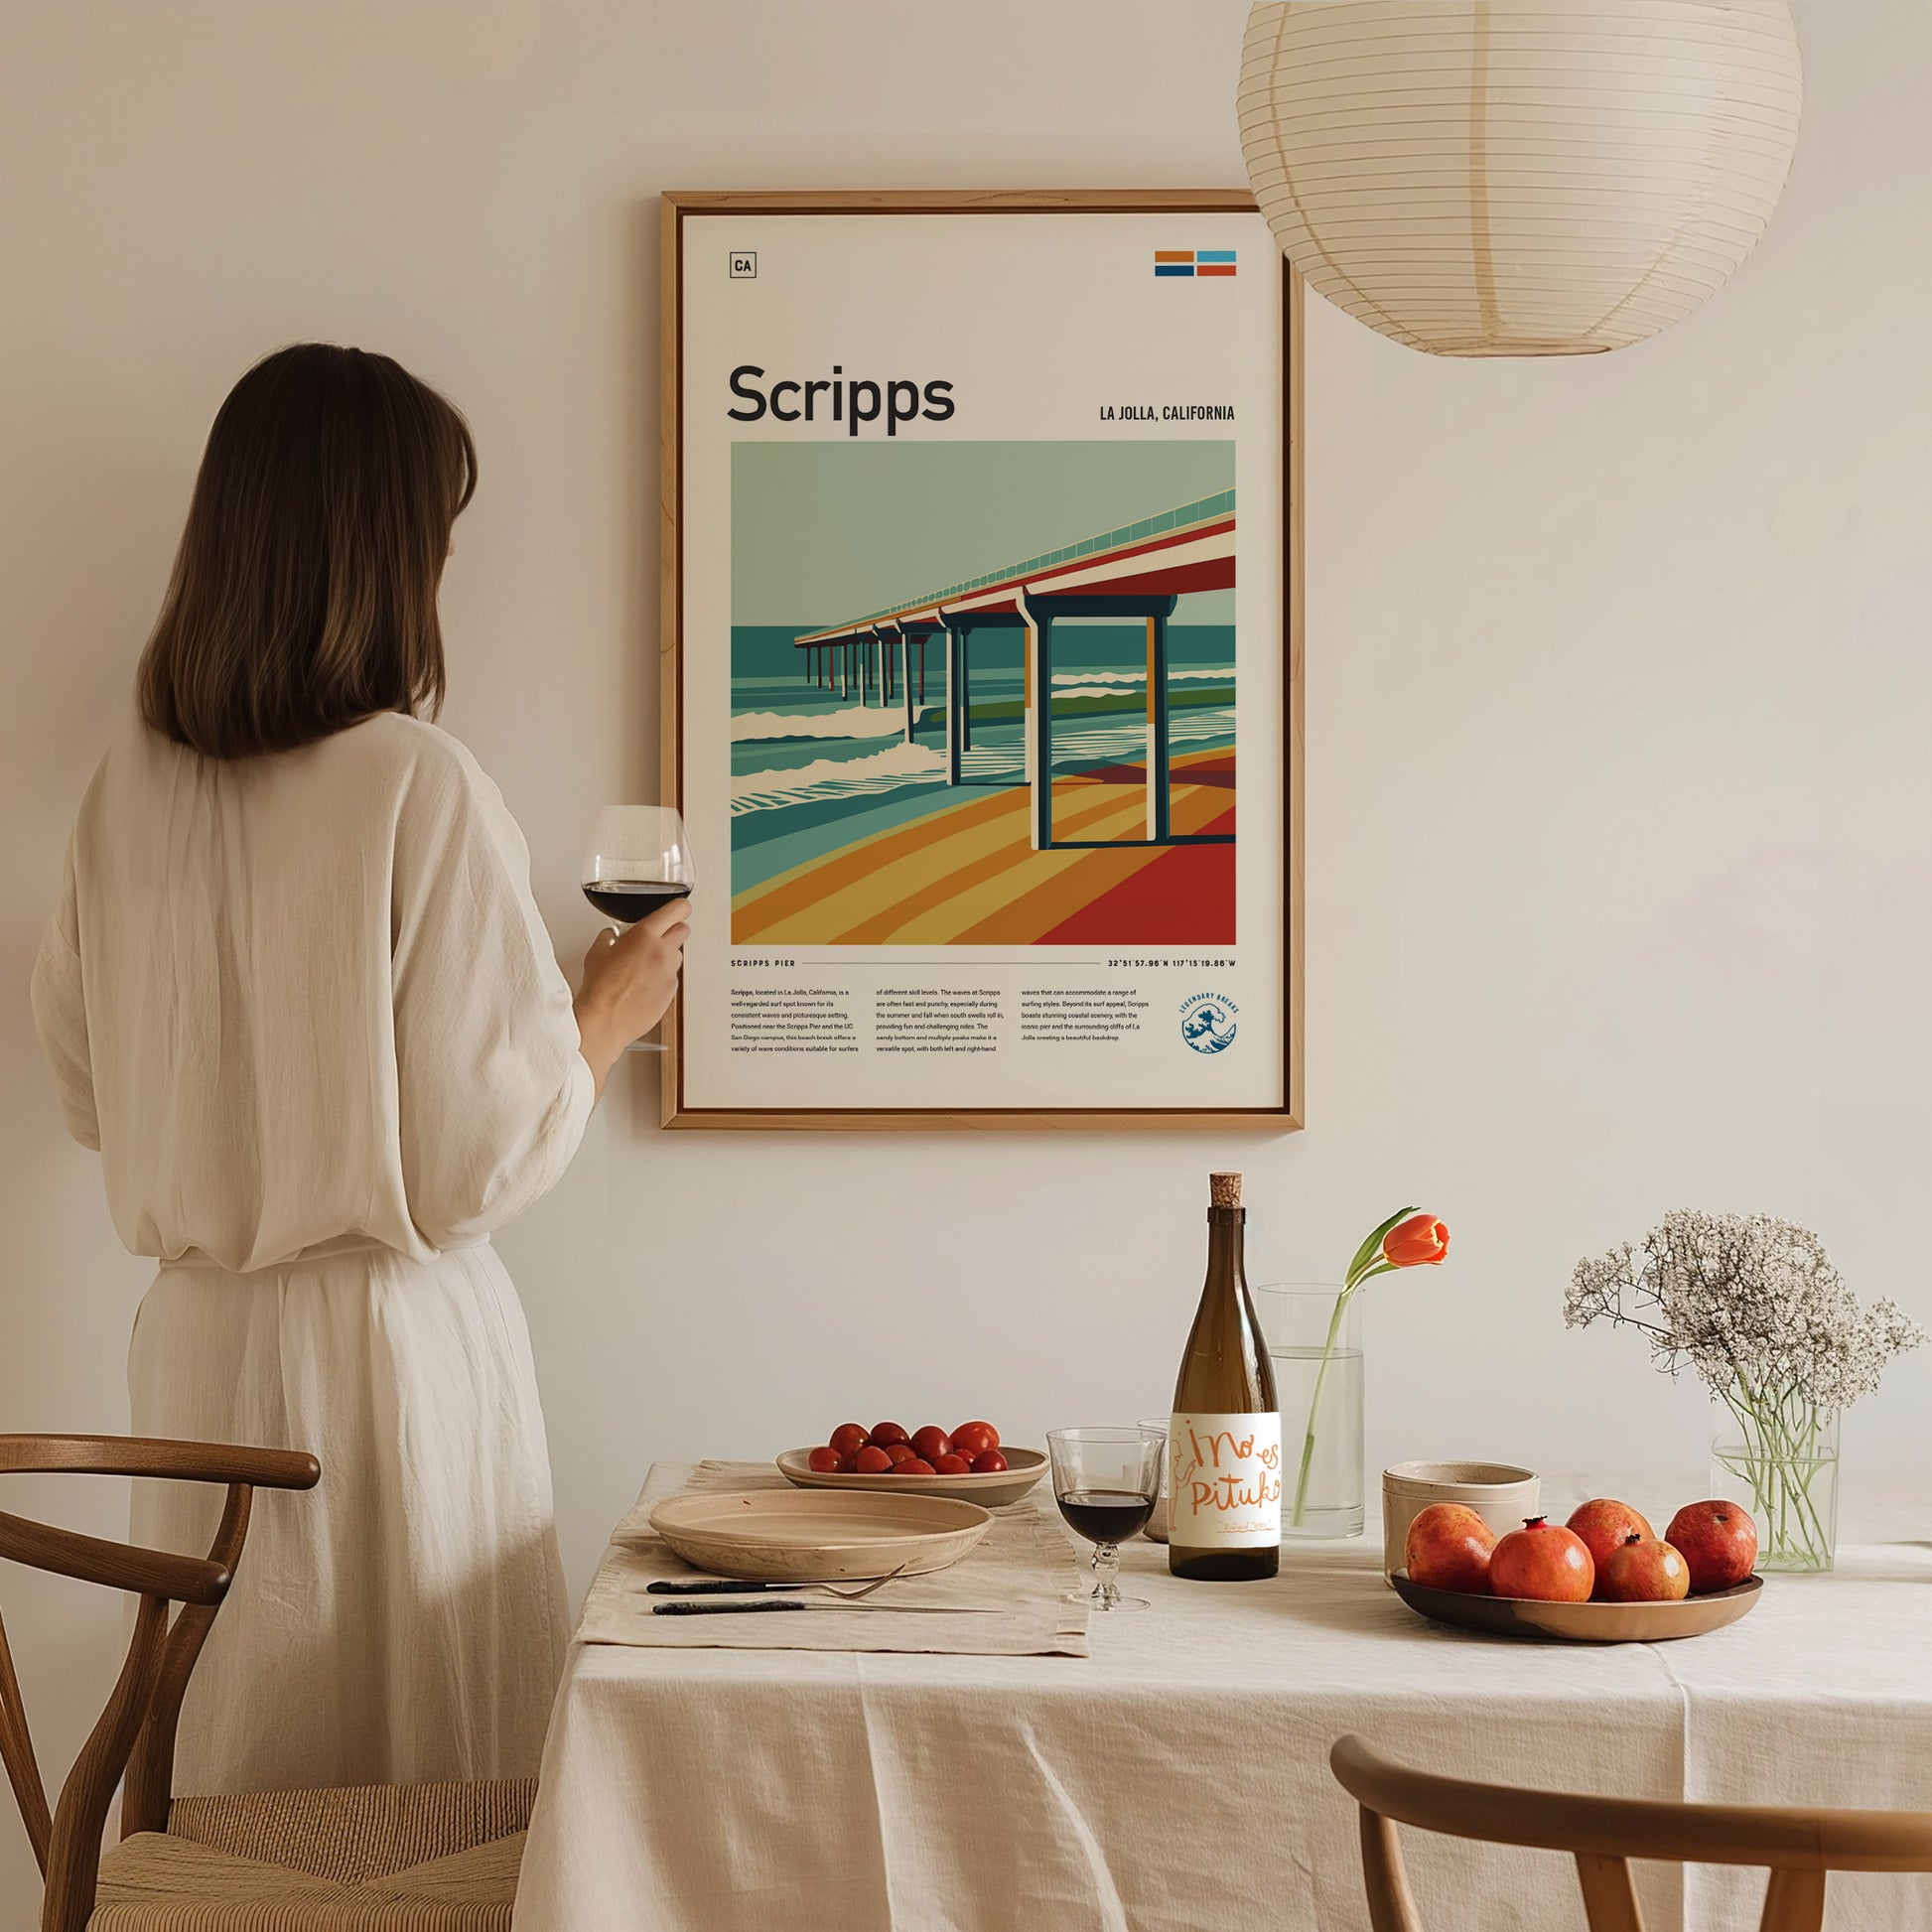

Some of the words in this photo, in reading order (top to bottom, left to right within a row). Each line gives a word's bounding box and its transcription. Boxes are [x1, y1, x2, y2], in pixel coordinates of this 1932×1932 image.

[733, 260, 753, 272] CA
[726, 365, 956, 437] Scripps
[1099, 406, 1116, 420] LA
[1118, 406, 1160, 422] JOLLA,
[1162, 406, 1236, 420] CALIFORNIA
[1178, 992, 1215, 1014] LEGENDARY
[1216, 994, 1240, 1014] BREAKS
[1256, 1443, 1279, 1470] es
